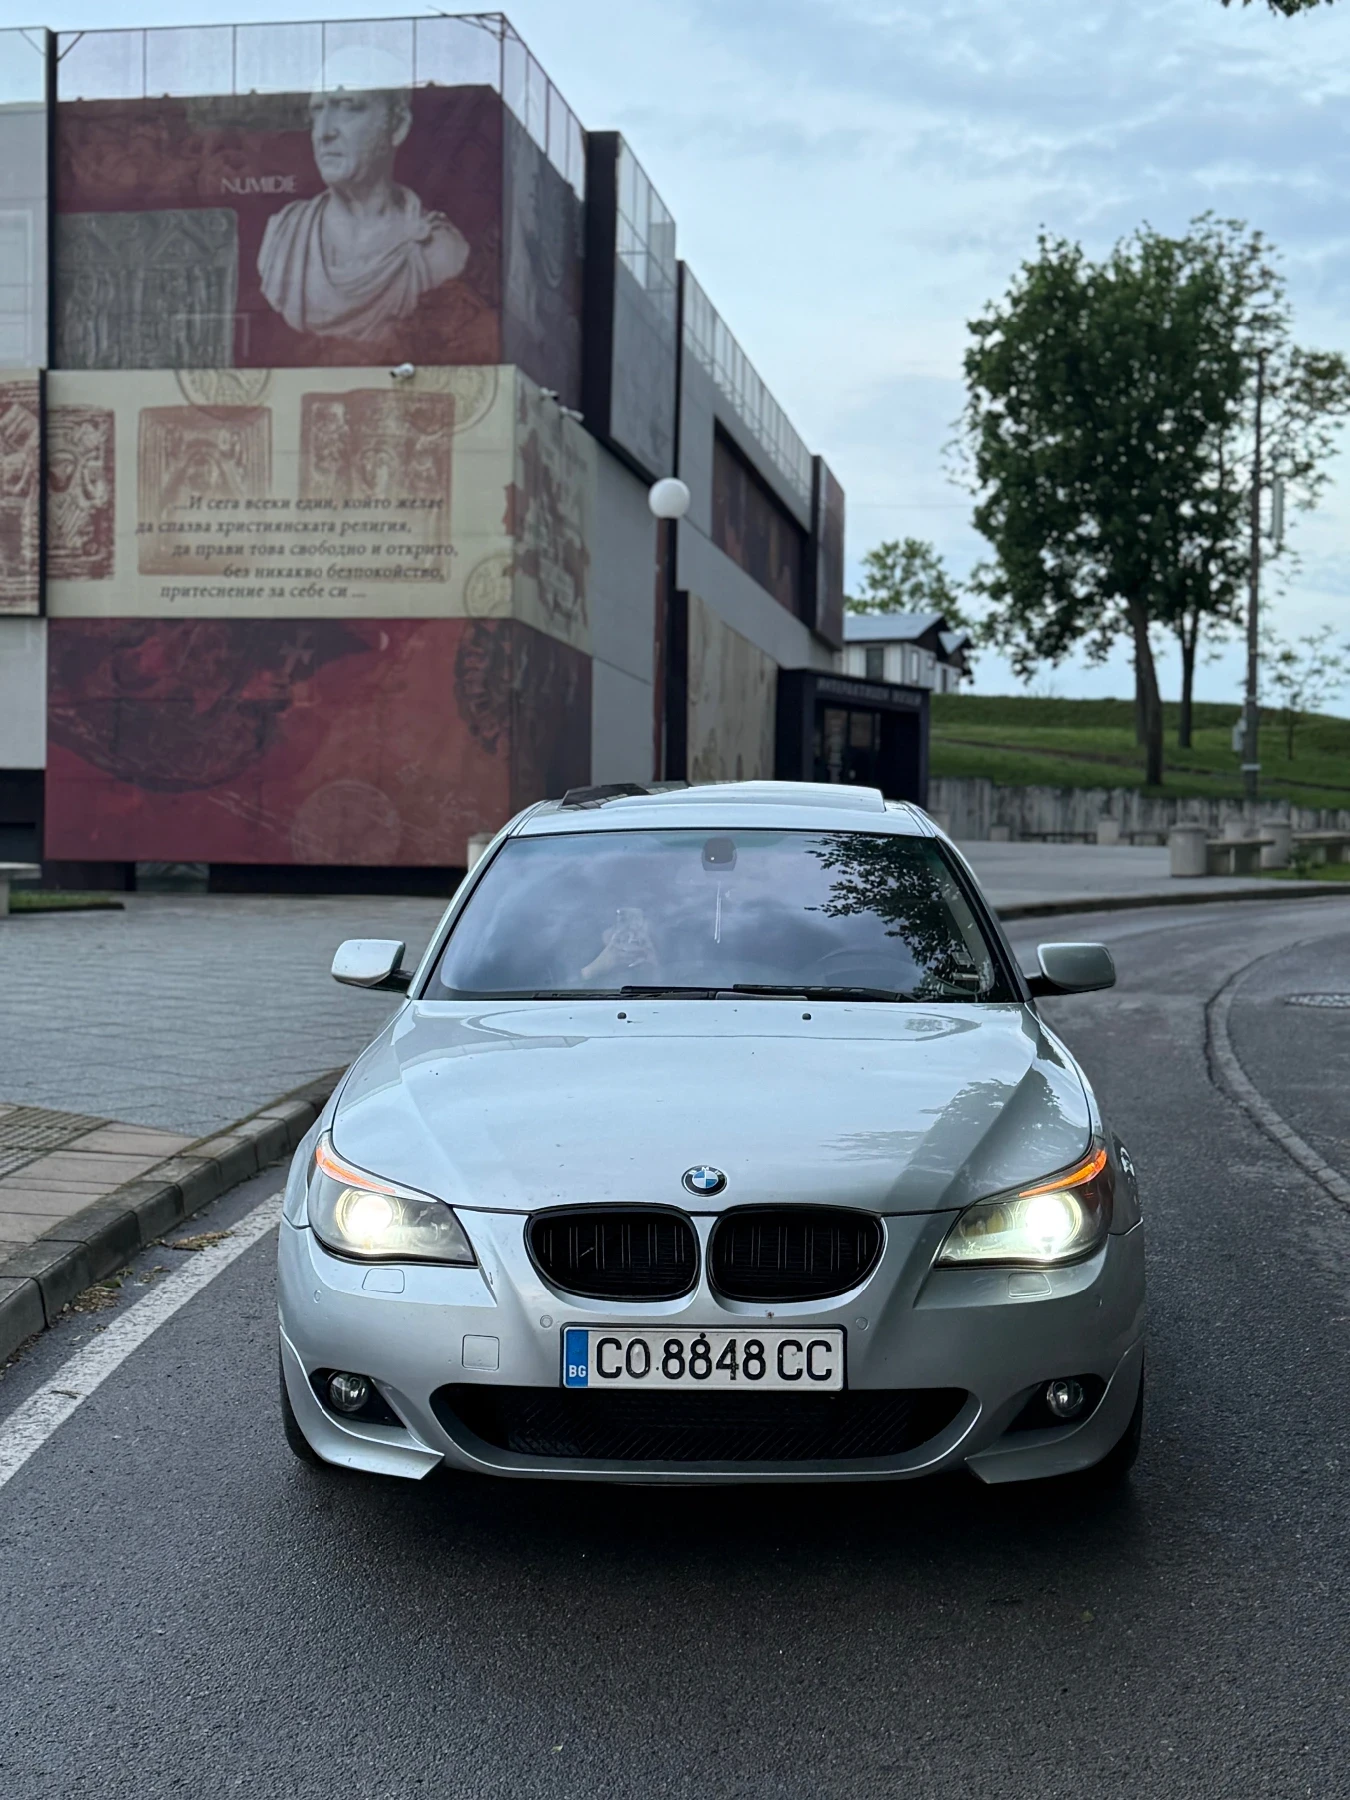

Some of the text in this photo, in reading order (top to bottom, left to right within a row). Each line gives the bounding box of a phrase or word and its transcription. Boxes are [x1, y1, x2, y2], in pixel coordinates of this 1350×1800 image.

[207, 499, 240, 511] сега
[245, 498, 290, 511] всеки
[342, 497, 392, 510] който
[135, 520, 412, 538] да спазва християнската религия,
[172, 540, 459, 560] да прави това свободно и открито,
[223, 562, 445, 580] без никакво безпокойство,
[160, 585, 265, 603] притеснение
[268, 585, 285, 598] за
[290, 582, 325, 598] себе
[328, 585, 348, 598] си
[661, 1337, 767, 1381] 8848
[777, 1339, 832, 1382] CC
[569, 1365, 587, 1378] BG
